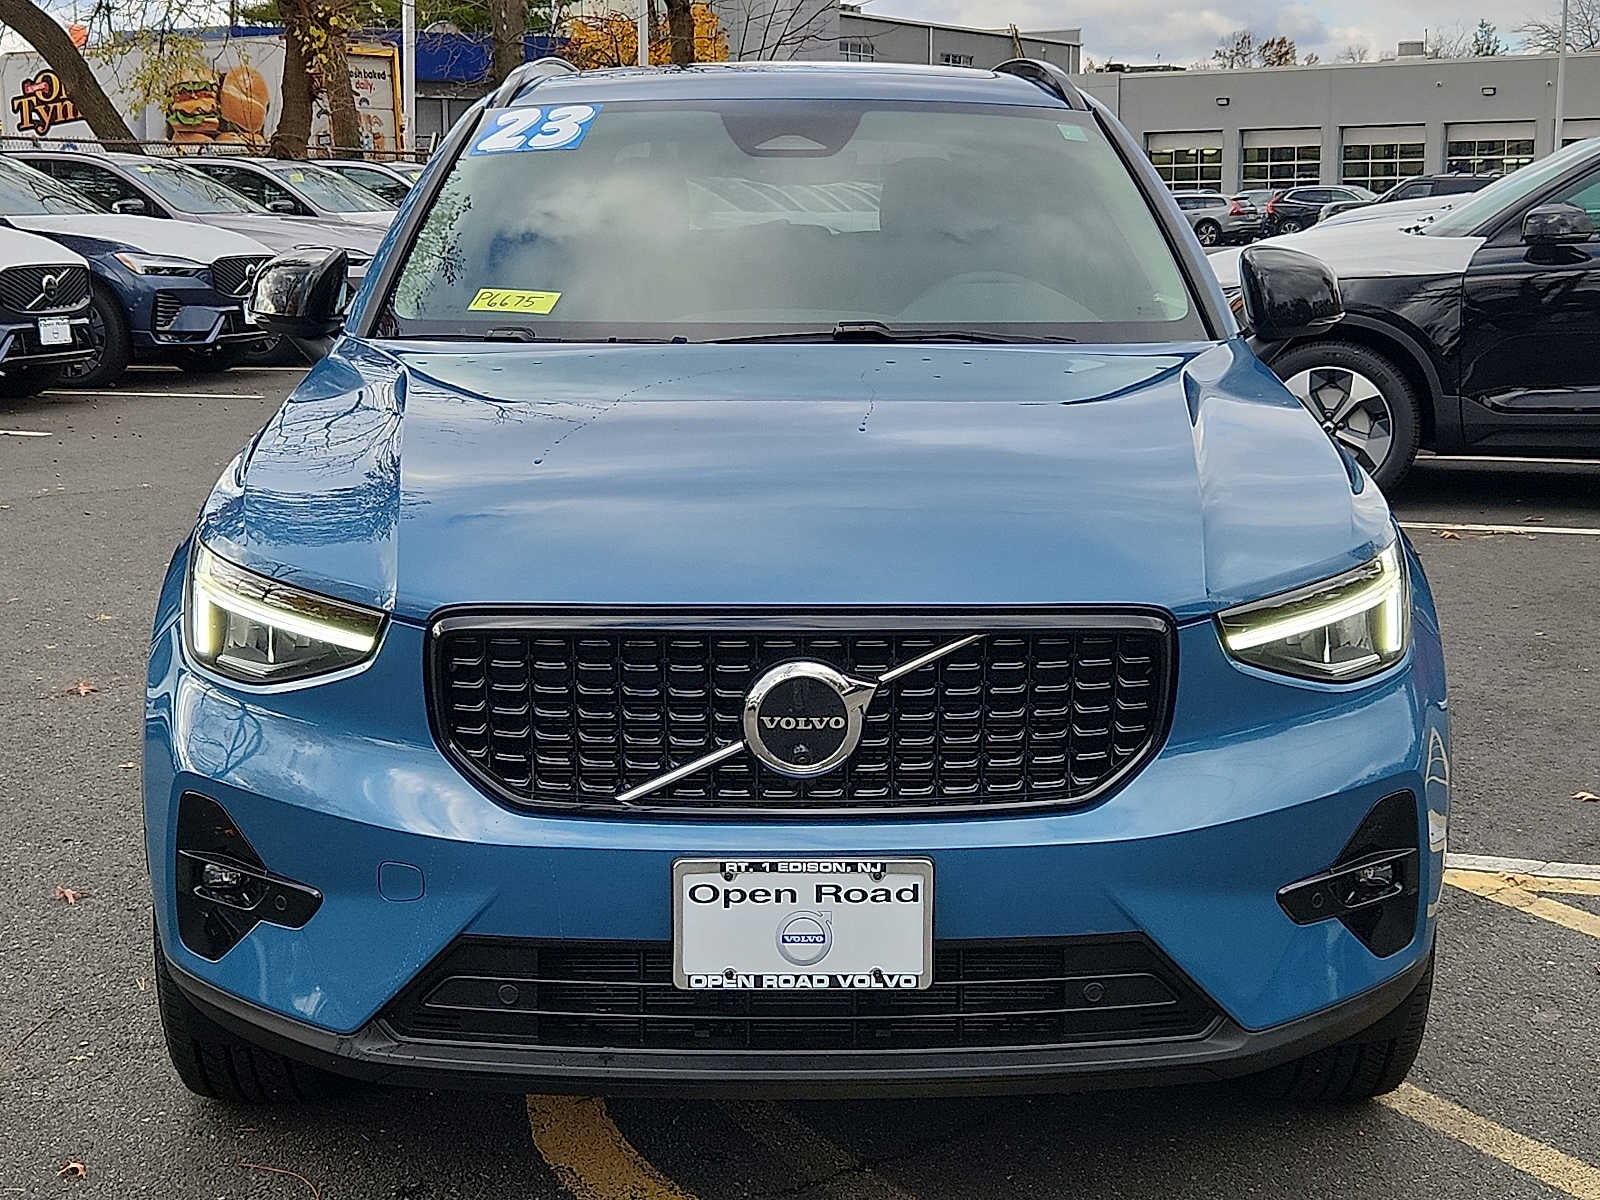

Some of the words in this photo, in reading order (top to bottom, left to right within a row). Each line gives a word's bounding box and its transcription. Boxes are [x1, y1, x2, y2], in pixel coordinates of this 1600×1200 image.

[477, 105, 596, 152] 23
[473, 291, 545, 308] P6675
[760, 716, 846, 730] VOLVO
[725, 862, 754, 873] RT.
[761, 862, 770, 873] 1
[777, 862, 851, 873] EDISON,
[857, 862, 881, 873] NJ
[688, 884, 798, 909] Open
[815, 883, 920, 904] Road
[783, 935, 825, 943] VOLVO
[689, 974, 755, 988] OPEN
[762, 974, 830, 988] ROAD
[836, 974, 917, 988] VOLVO
